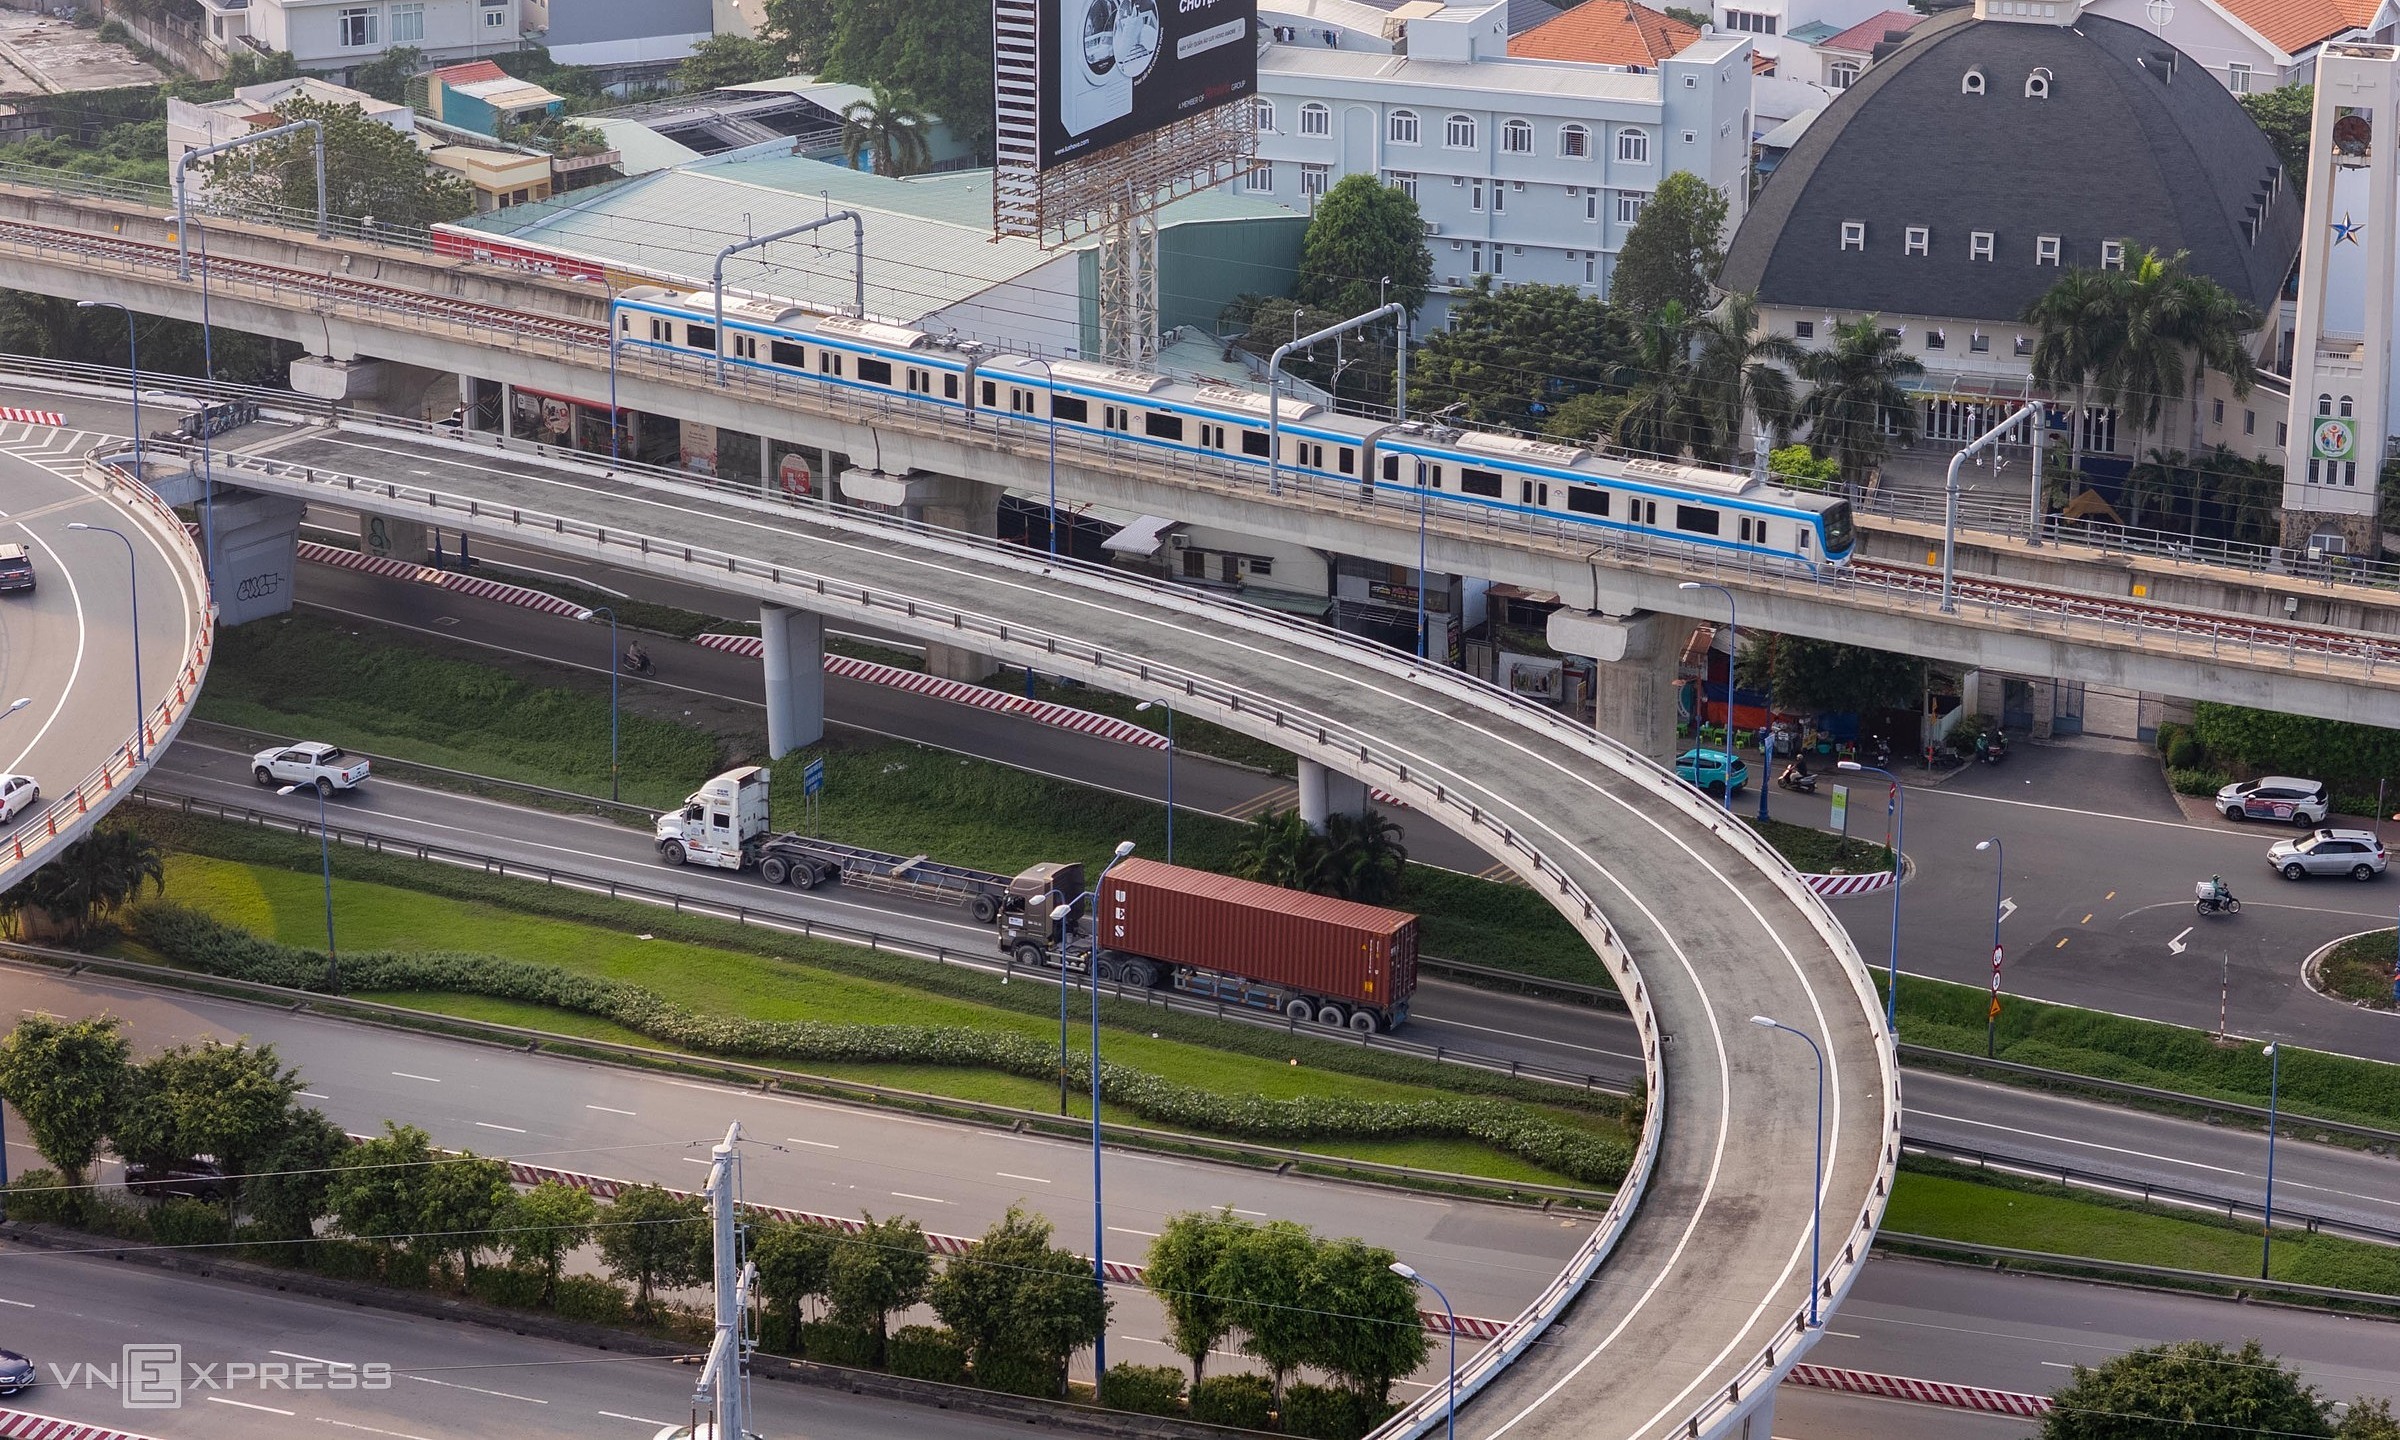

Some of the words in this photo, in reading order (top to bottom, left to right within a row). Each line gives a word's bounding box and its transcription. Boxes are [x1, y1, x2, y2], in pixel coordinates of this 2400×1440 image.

[1179, 0, 1220, 13] CHU
[1231, 80, 1246, 91] GROUP
[1182, 96, 1199, 108] MEMBER
[1115, 889, 1126, 938] UES
